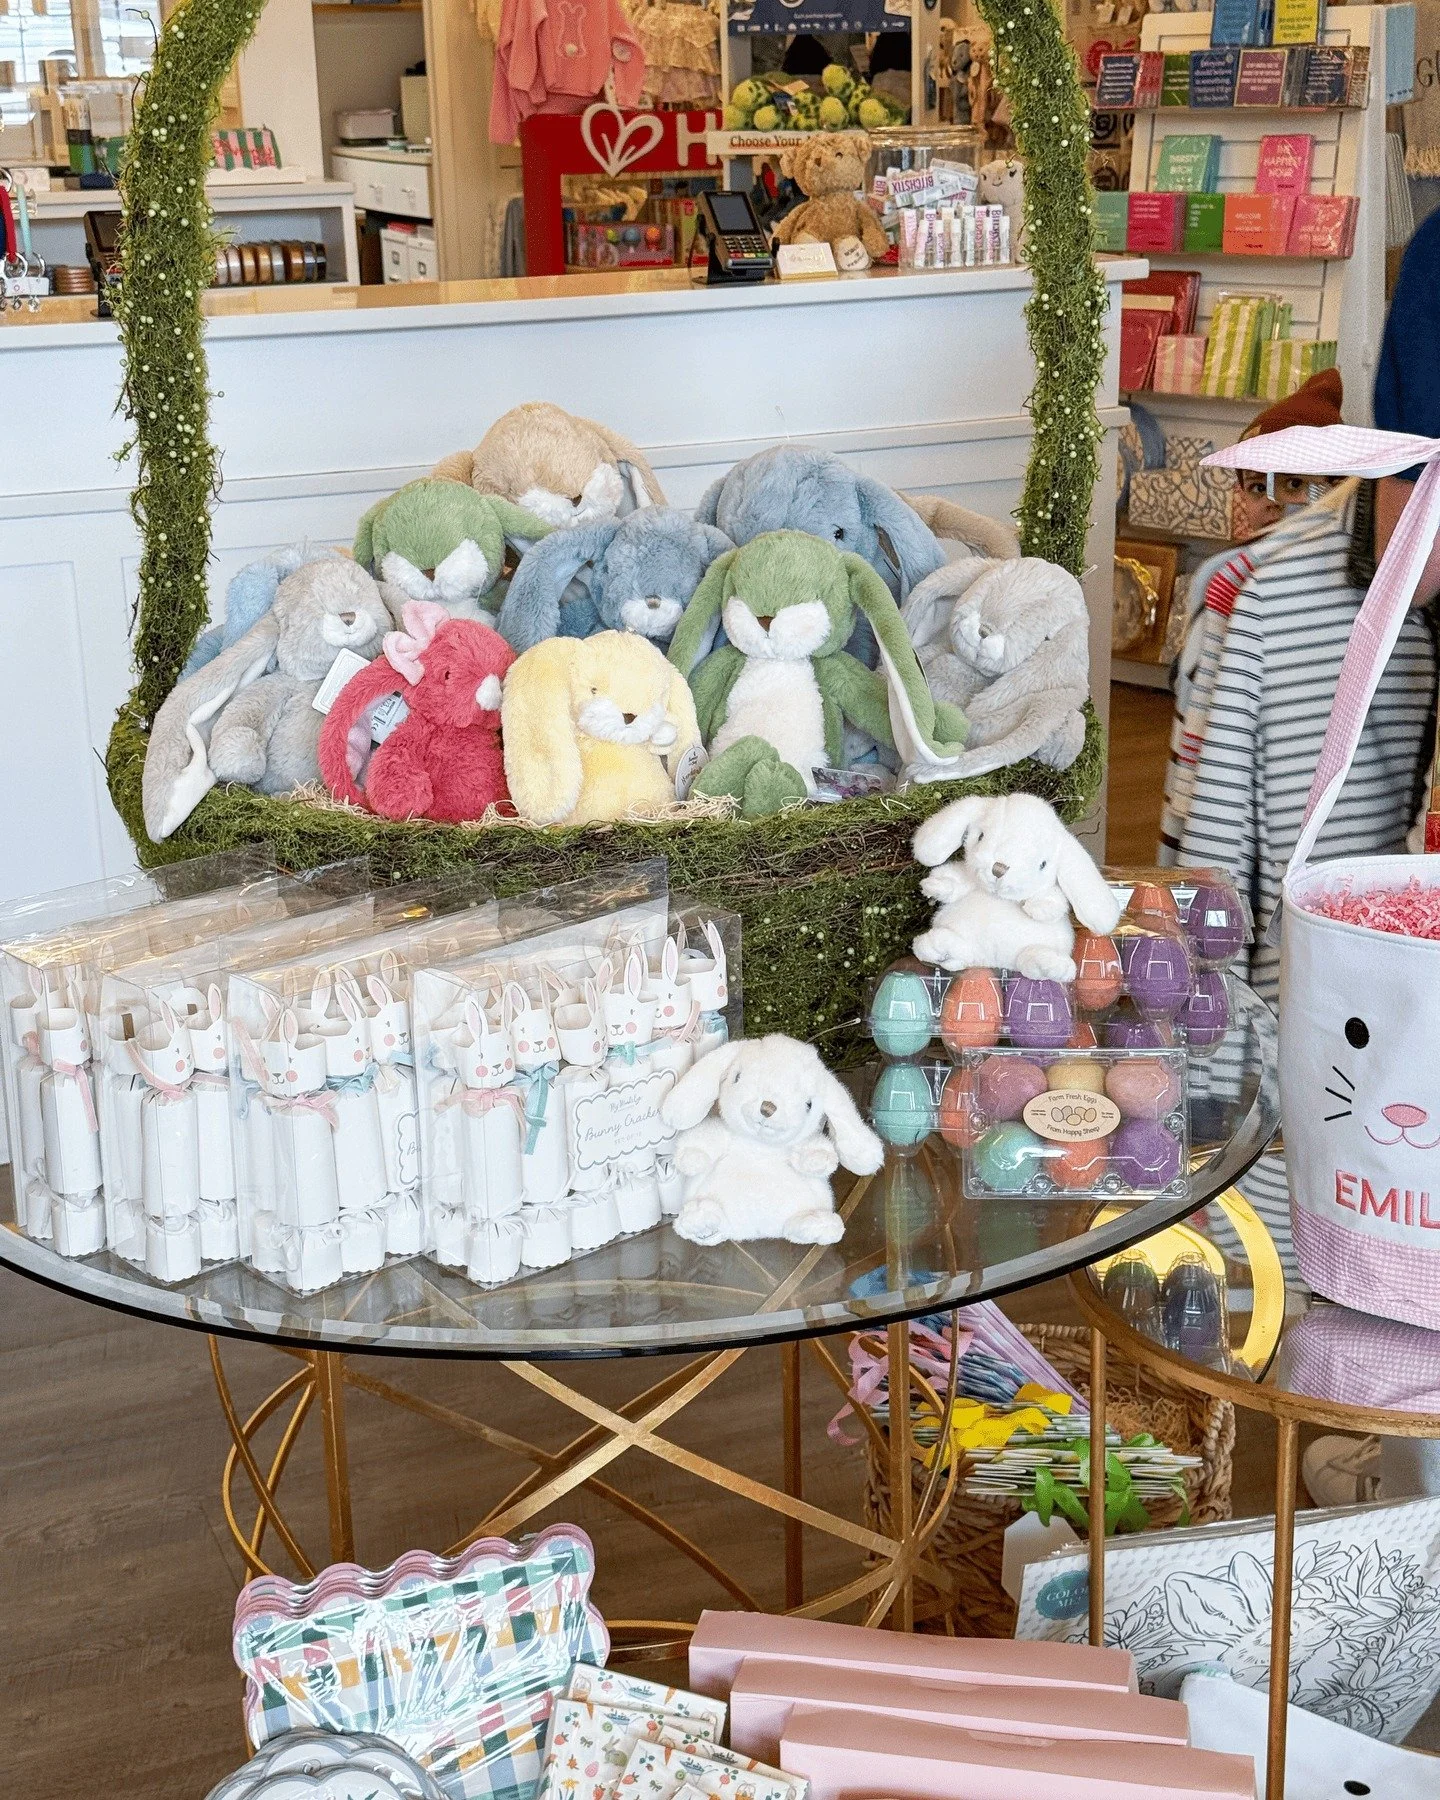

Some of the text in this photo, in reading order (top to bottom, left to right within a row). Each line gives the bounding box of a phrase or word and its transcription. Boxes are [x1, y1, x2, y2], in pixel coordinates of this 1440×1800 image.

[730, 135, 802, 147] Choose Your
[892, 175, 934, 194] BITCHSTIX
[1048, 1094, 1065, 1102] Farm
[1083, 1094, 1098, 1104] Eggs
[585, 1125, 622, 1142] Bunny
[1046, 1123, 1101, 1137] From Happy Sheep
